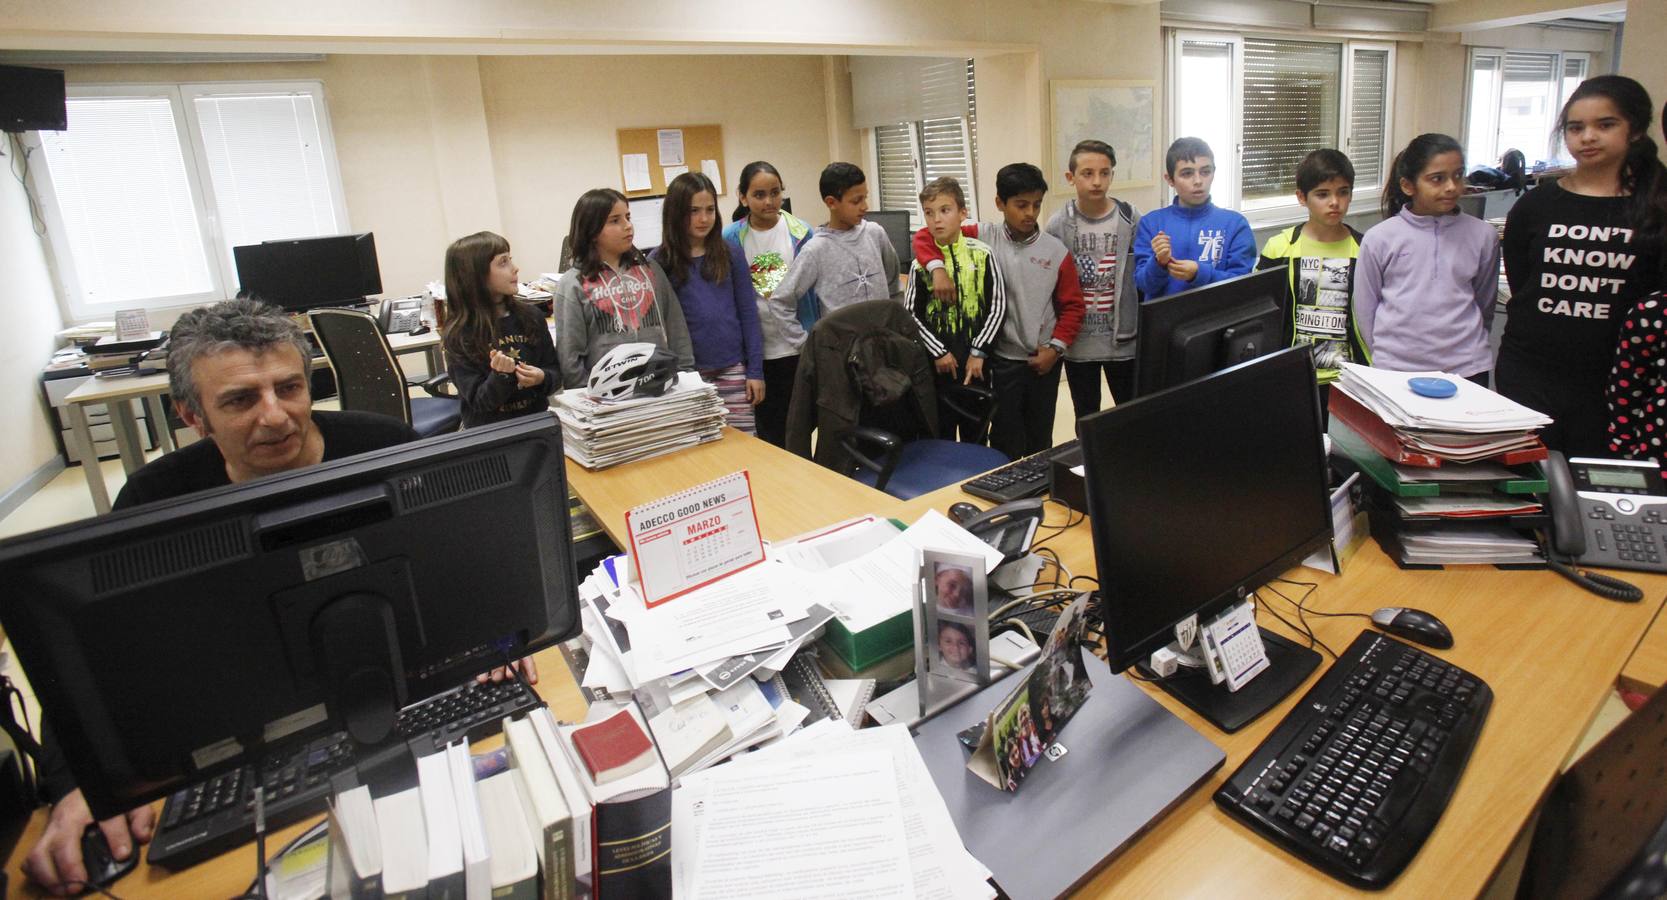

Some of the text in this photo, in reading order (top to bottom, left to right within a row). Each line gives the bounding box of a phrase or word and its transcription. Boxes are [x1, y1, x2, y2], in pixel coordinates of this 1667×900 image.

[1548, 224, 1633, 243] DON'T
[1301, 259, 1319, 269] NYC
[1543, 247, 1636, 270] KNOW
[1541, 273, 1626, 294] DON'T
[1538, 297, 1611, 319] CARE
[640, 493, 726, 531] ADECCO GOOD NEWS
[687, 515, 721, 535] MARZO
